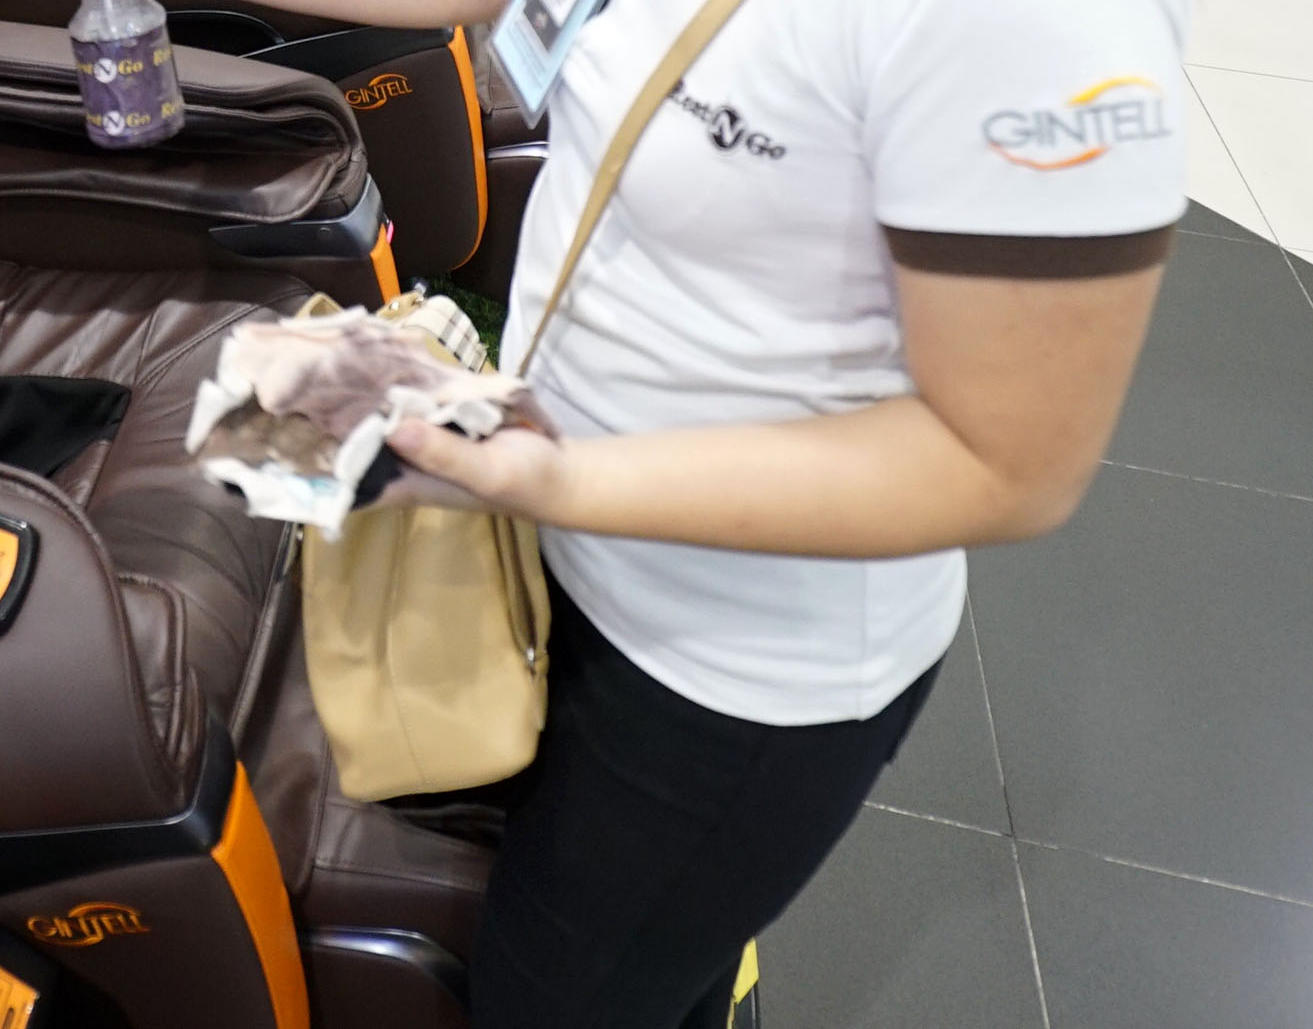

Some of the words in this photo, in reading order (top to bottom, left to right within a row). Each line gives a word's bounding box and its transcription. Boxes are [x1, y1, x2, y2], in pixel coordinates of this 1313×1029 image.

[344, 80, 413, 105] GINTELL
[982, 100, 1173, 148] GINTELL
[745, 132, 786, 160] Go
[28, 913, 150, 938] GINTELL
